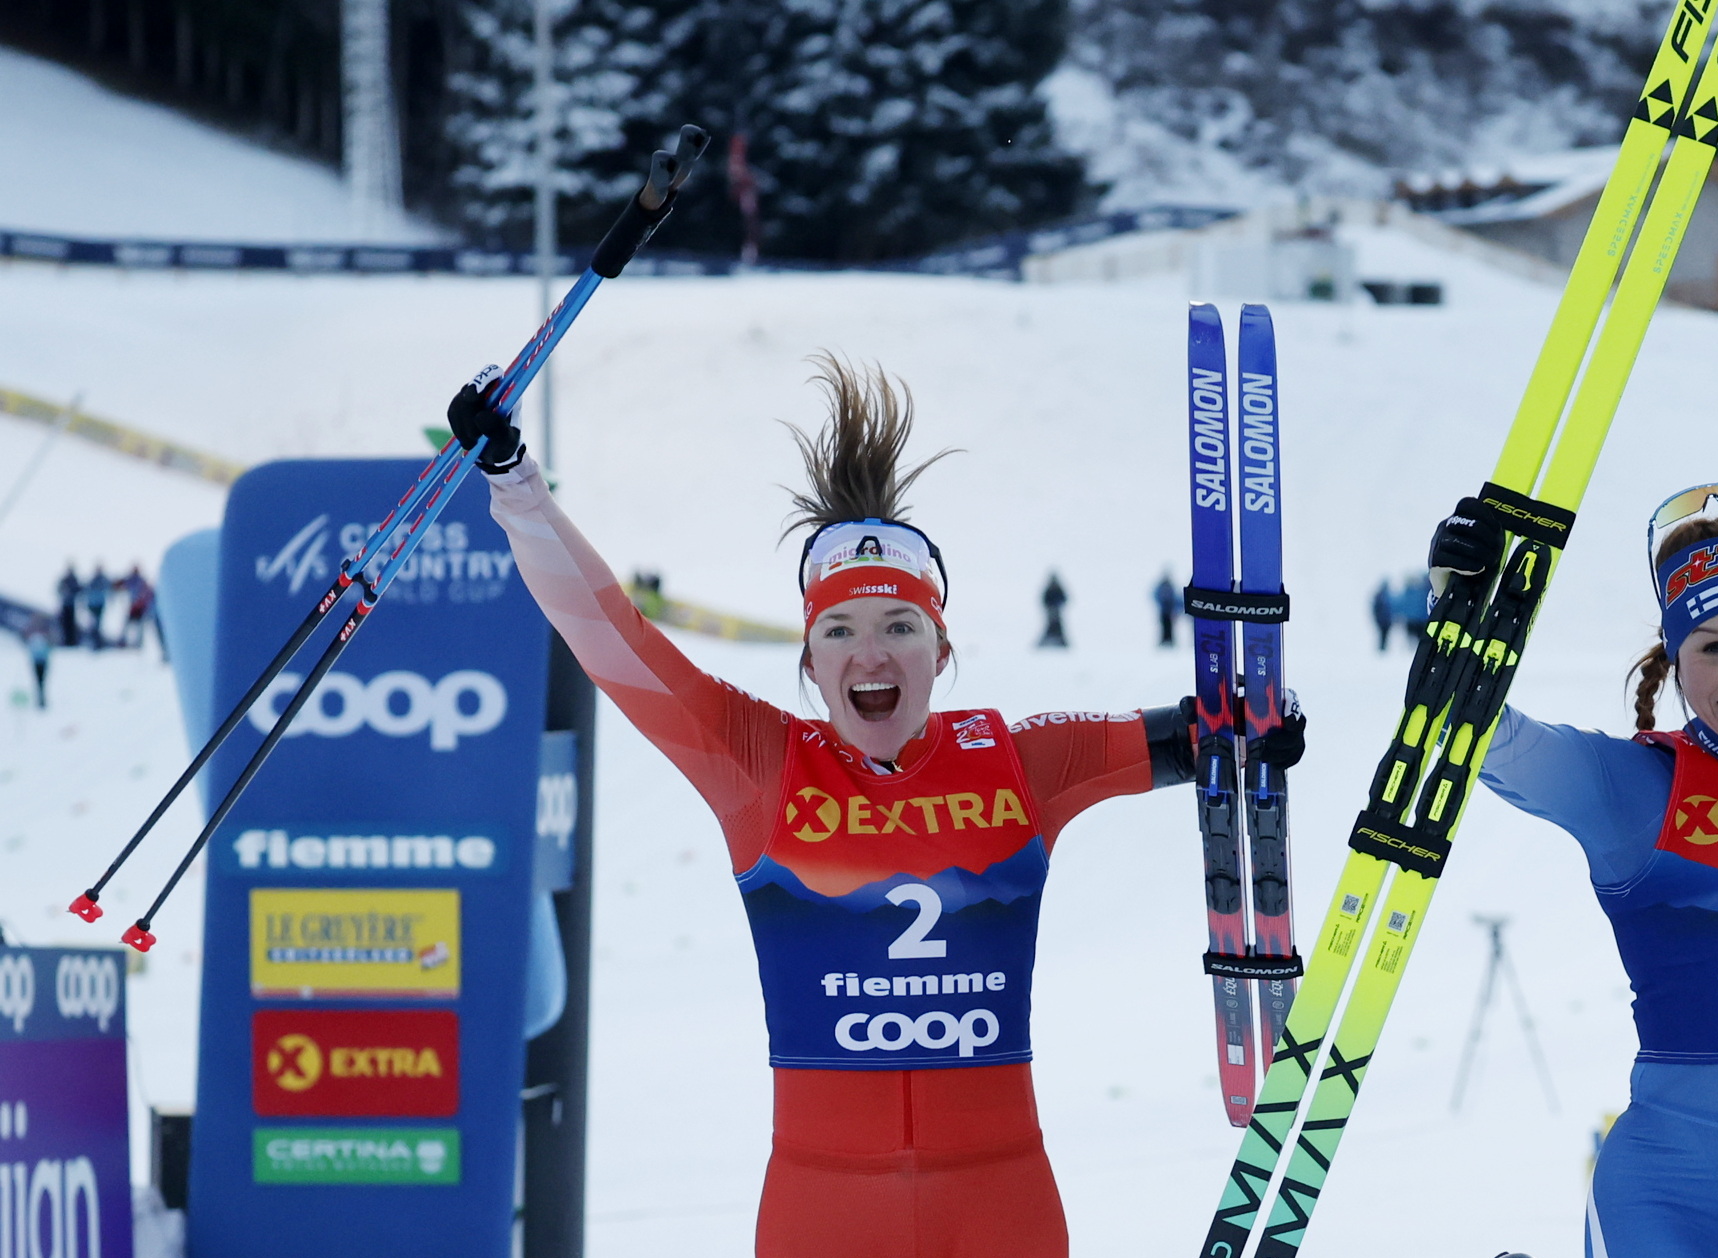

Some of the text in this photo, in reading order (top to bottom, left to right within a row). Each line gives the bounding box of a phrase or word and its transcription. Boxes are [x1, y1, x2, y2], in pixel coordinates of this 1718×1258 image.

[1192, 367, 1227, 511] SALOMON
[1242, 372, 1275, 514] SALOMON
[1483, 497, 1567, 532] FISCHER
[1191, 599, 1284, 615] SALOMON
[247, 670, 507, 750] coop
[847, 788, 1030, 836] EXTRA
[233, 830, 496, 869] fiemme
[1357, 827, 1441, 862] FISCHER
[884, 883, 947, 960] 2
[56, 953, 119, 1033] coop
[821, 972, 1006, 998] fiemme
[1210, 963, 1298, 976] SALOMON
[835, 1009, 1000, 1058] coop
[329, 1047, 442, 1078] EXTRA
[266, 1138, 412, 1159] CERTINA
[1217, 1025, 1326, 1230] MAX
[1266, 1042, 1374, 1248] MAX
